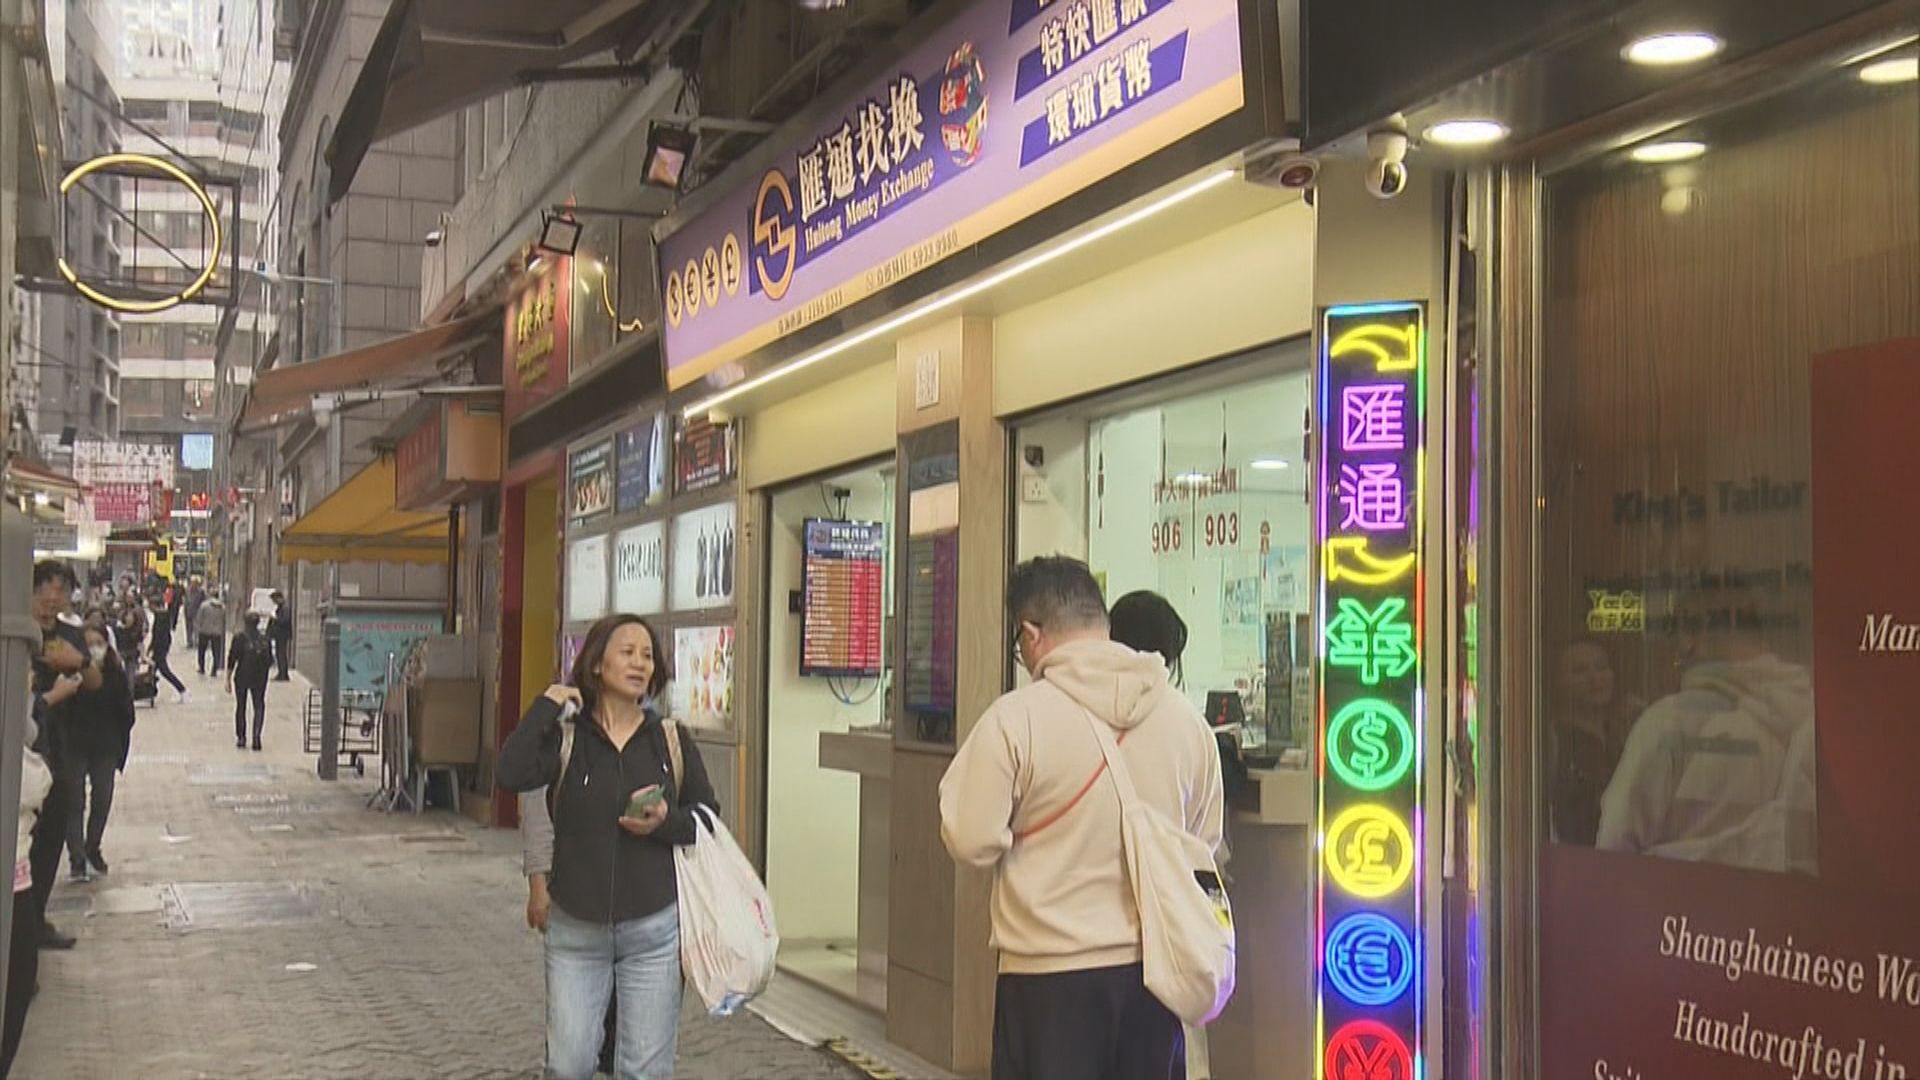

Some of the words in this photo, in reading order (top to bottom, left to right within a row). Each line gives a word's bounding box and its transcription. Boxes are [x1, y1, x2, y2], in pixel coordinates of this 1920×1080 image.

[1045, 39, 1152, 145] 環球貨幣
[798, 77, 925, 223] 匯通找換
[845, 191, 880, 230] Money
[880, 157, 934, 208] Exchange
[1339, 383, 1406, 530] 匯通
[1152, 518, 1181, 553] 906
[1205, 511, 1238, 546] 903
[1660, 915, 1865, 994] Shanghainese
[1673, 1000, 1865, 1080] Handcrafted
